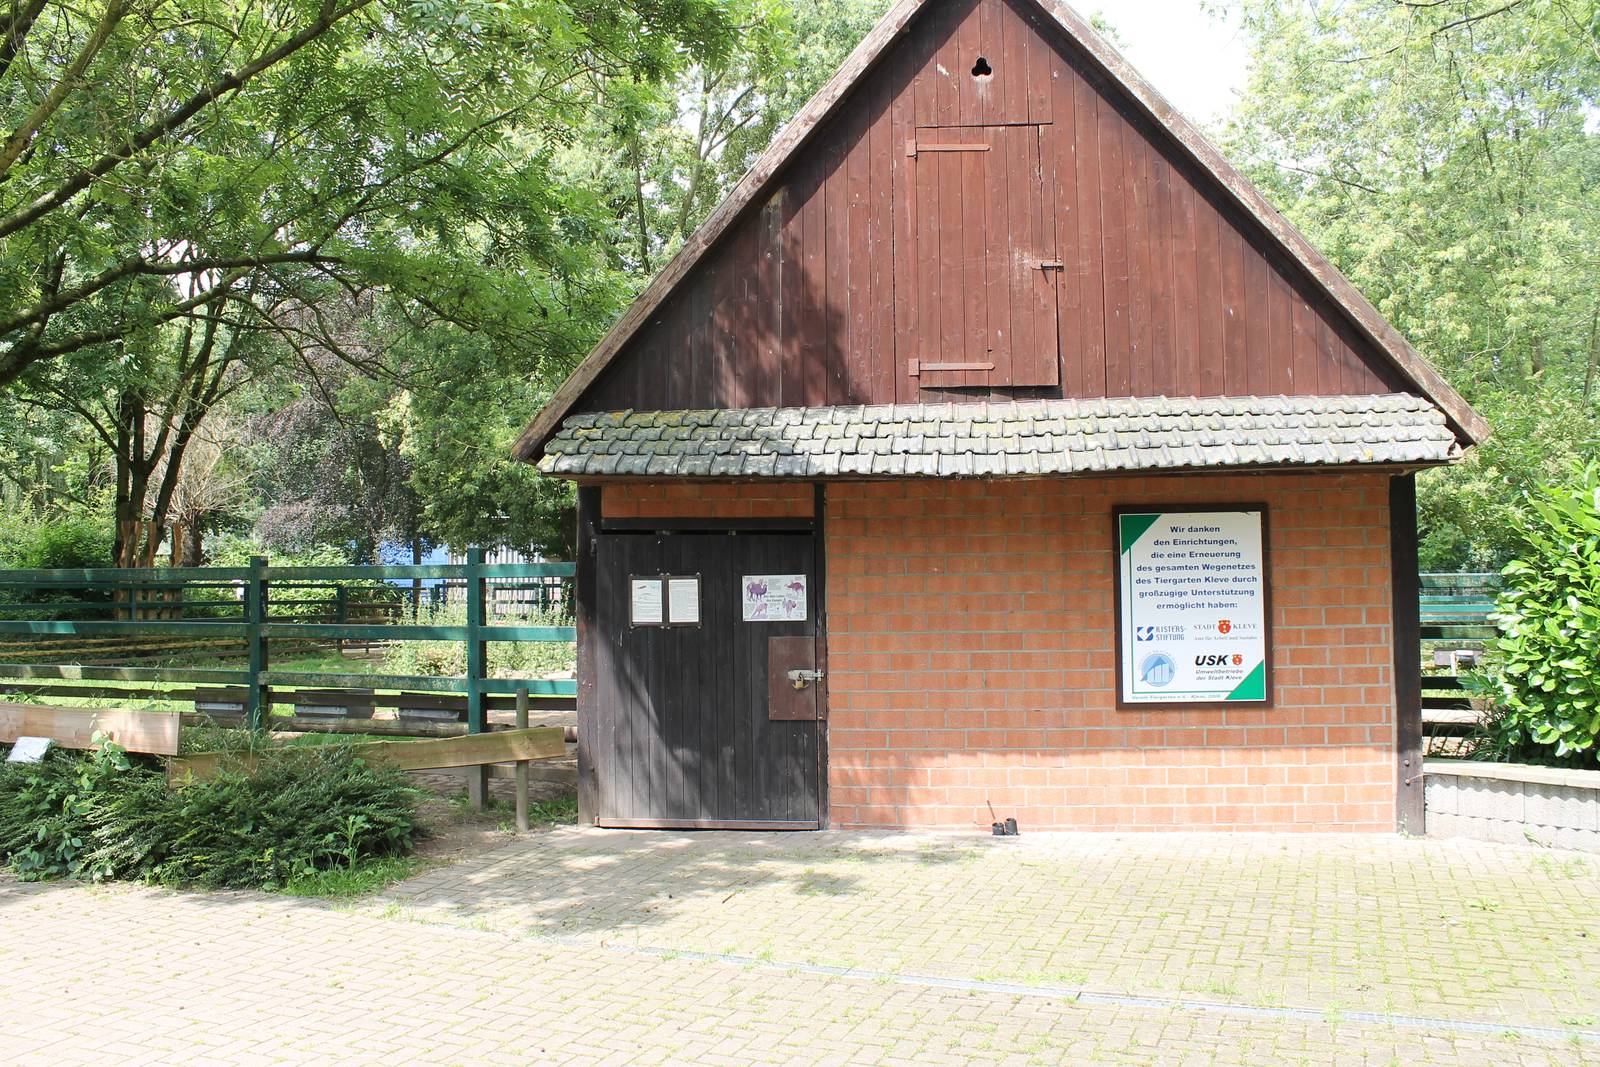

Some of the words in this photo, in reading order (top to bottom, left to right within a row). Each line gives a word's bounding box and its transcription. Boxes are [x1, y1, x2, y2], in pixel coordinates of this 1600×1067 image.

[1173, 539, 1237, 547] Einrichtungen,
[1189, 551, 1241, 559] Erneuerung
[1154, 577, 1201, 585] Tiergarten
[1139, 590, 1188, 598] großzügige
[1191, 589, 1254, 597] Unterstützung
[1157, 602, 1205, 610] ermöglicht
[1195, 655, 1228, 666] USK
